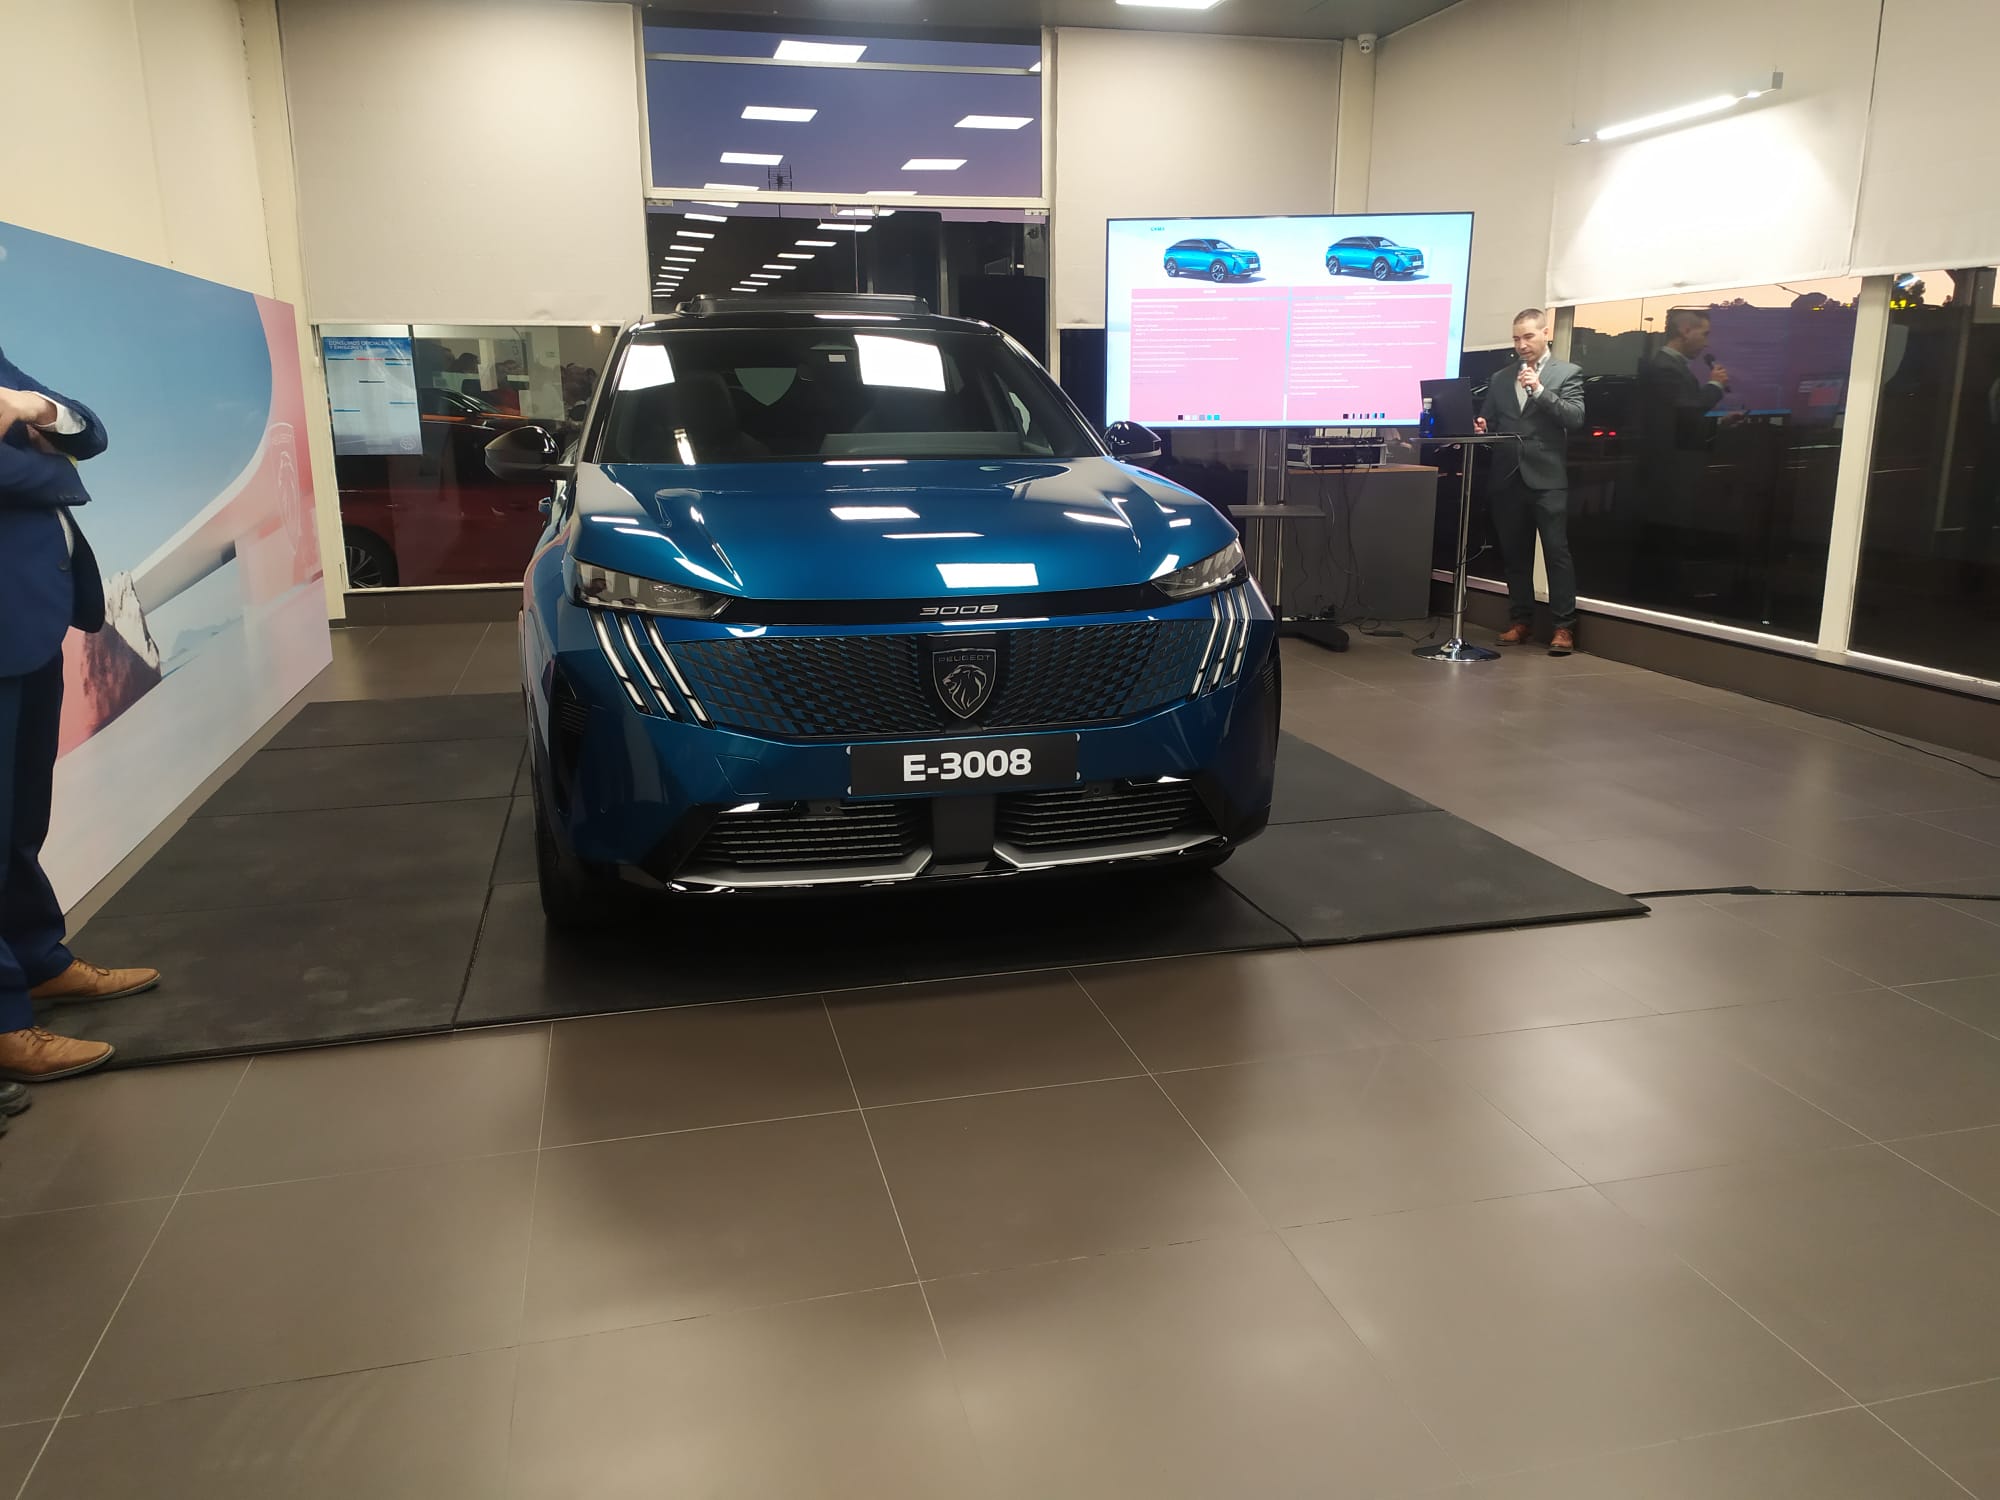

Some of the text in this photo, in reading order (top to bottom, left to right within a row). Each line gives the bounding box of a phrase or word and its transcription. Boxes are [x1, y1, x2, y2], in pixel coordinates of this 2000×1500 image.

[919, 604, 999, 616] 3008
[938, 654, 992, 663] PEUGEOT
[902, 748, 1032, 782] E-3008
